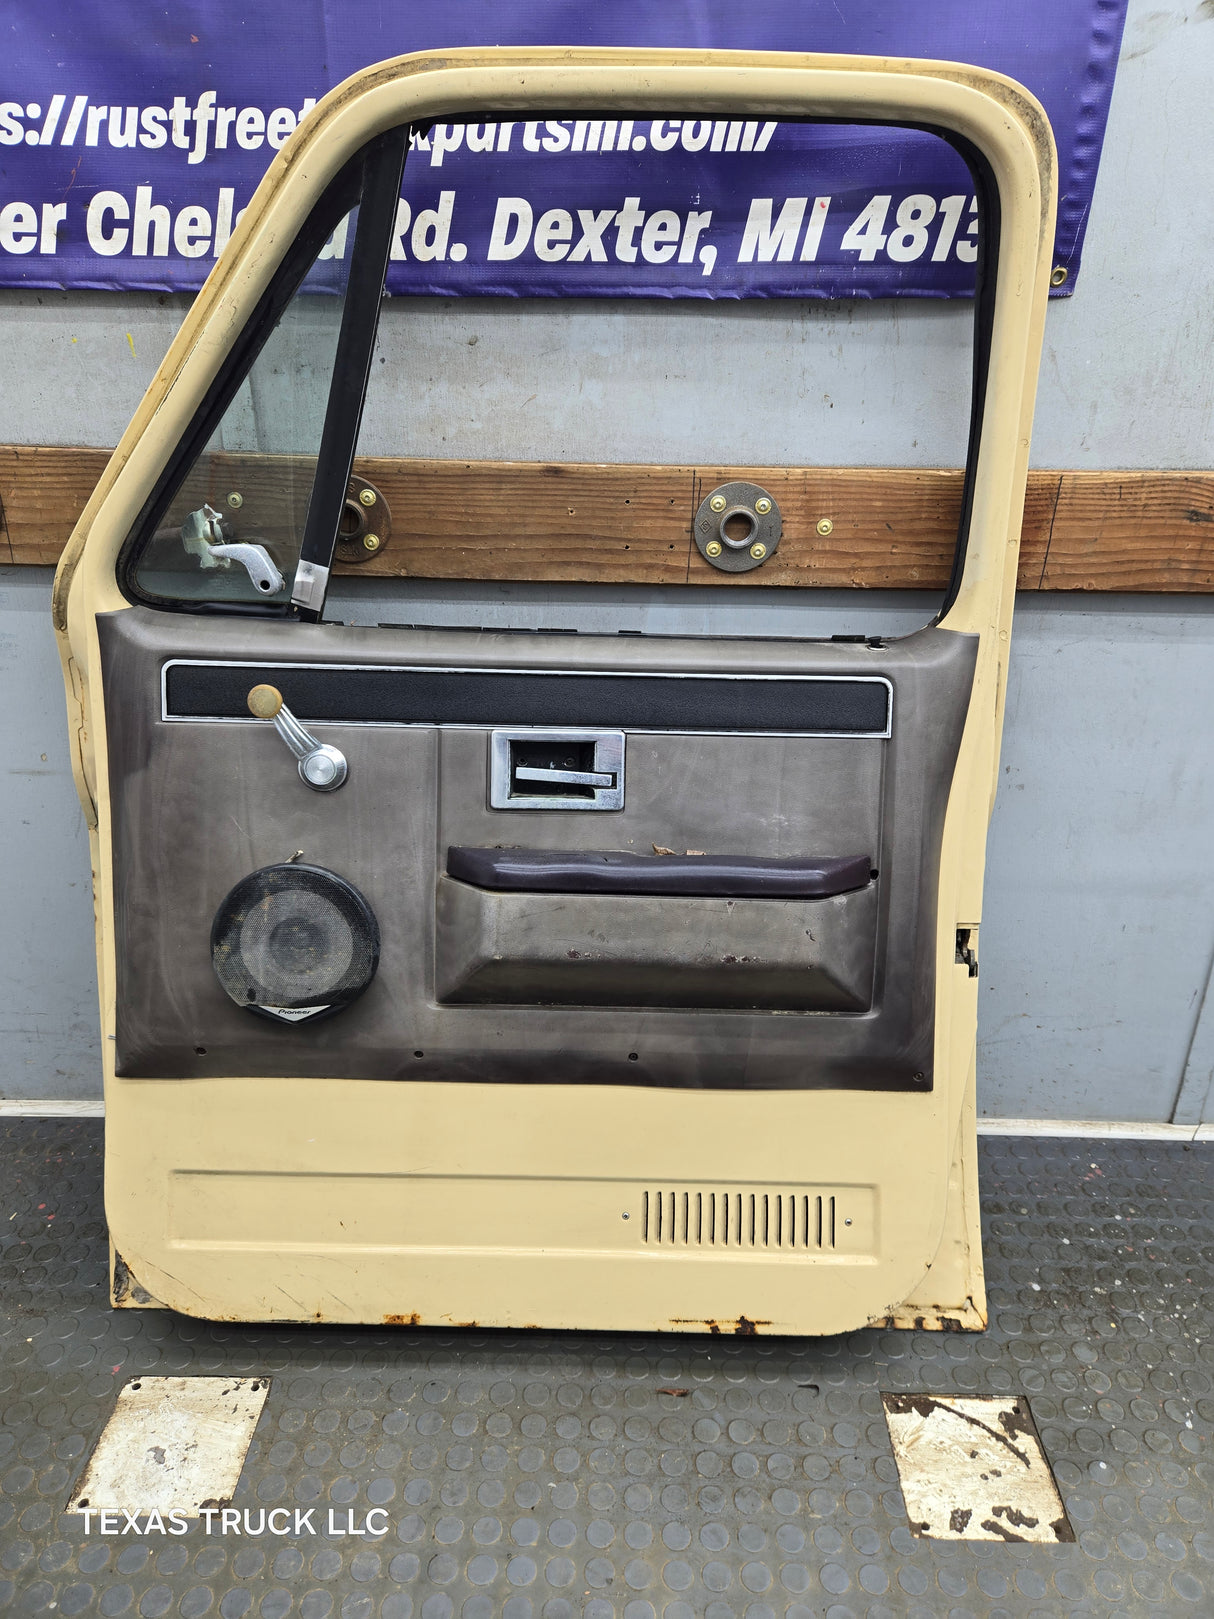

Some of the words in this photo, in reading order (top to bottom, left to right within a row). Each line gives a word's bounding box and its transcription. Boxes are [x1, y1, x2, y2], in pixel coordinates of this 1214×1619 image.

[0, 201, 67, 254] er
[487, 196, 718, 276] Dexter,
[737, 196, 832, 262] MI
